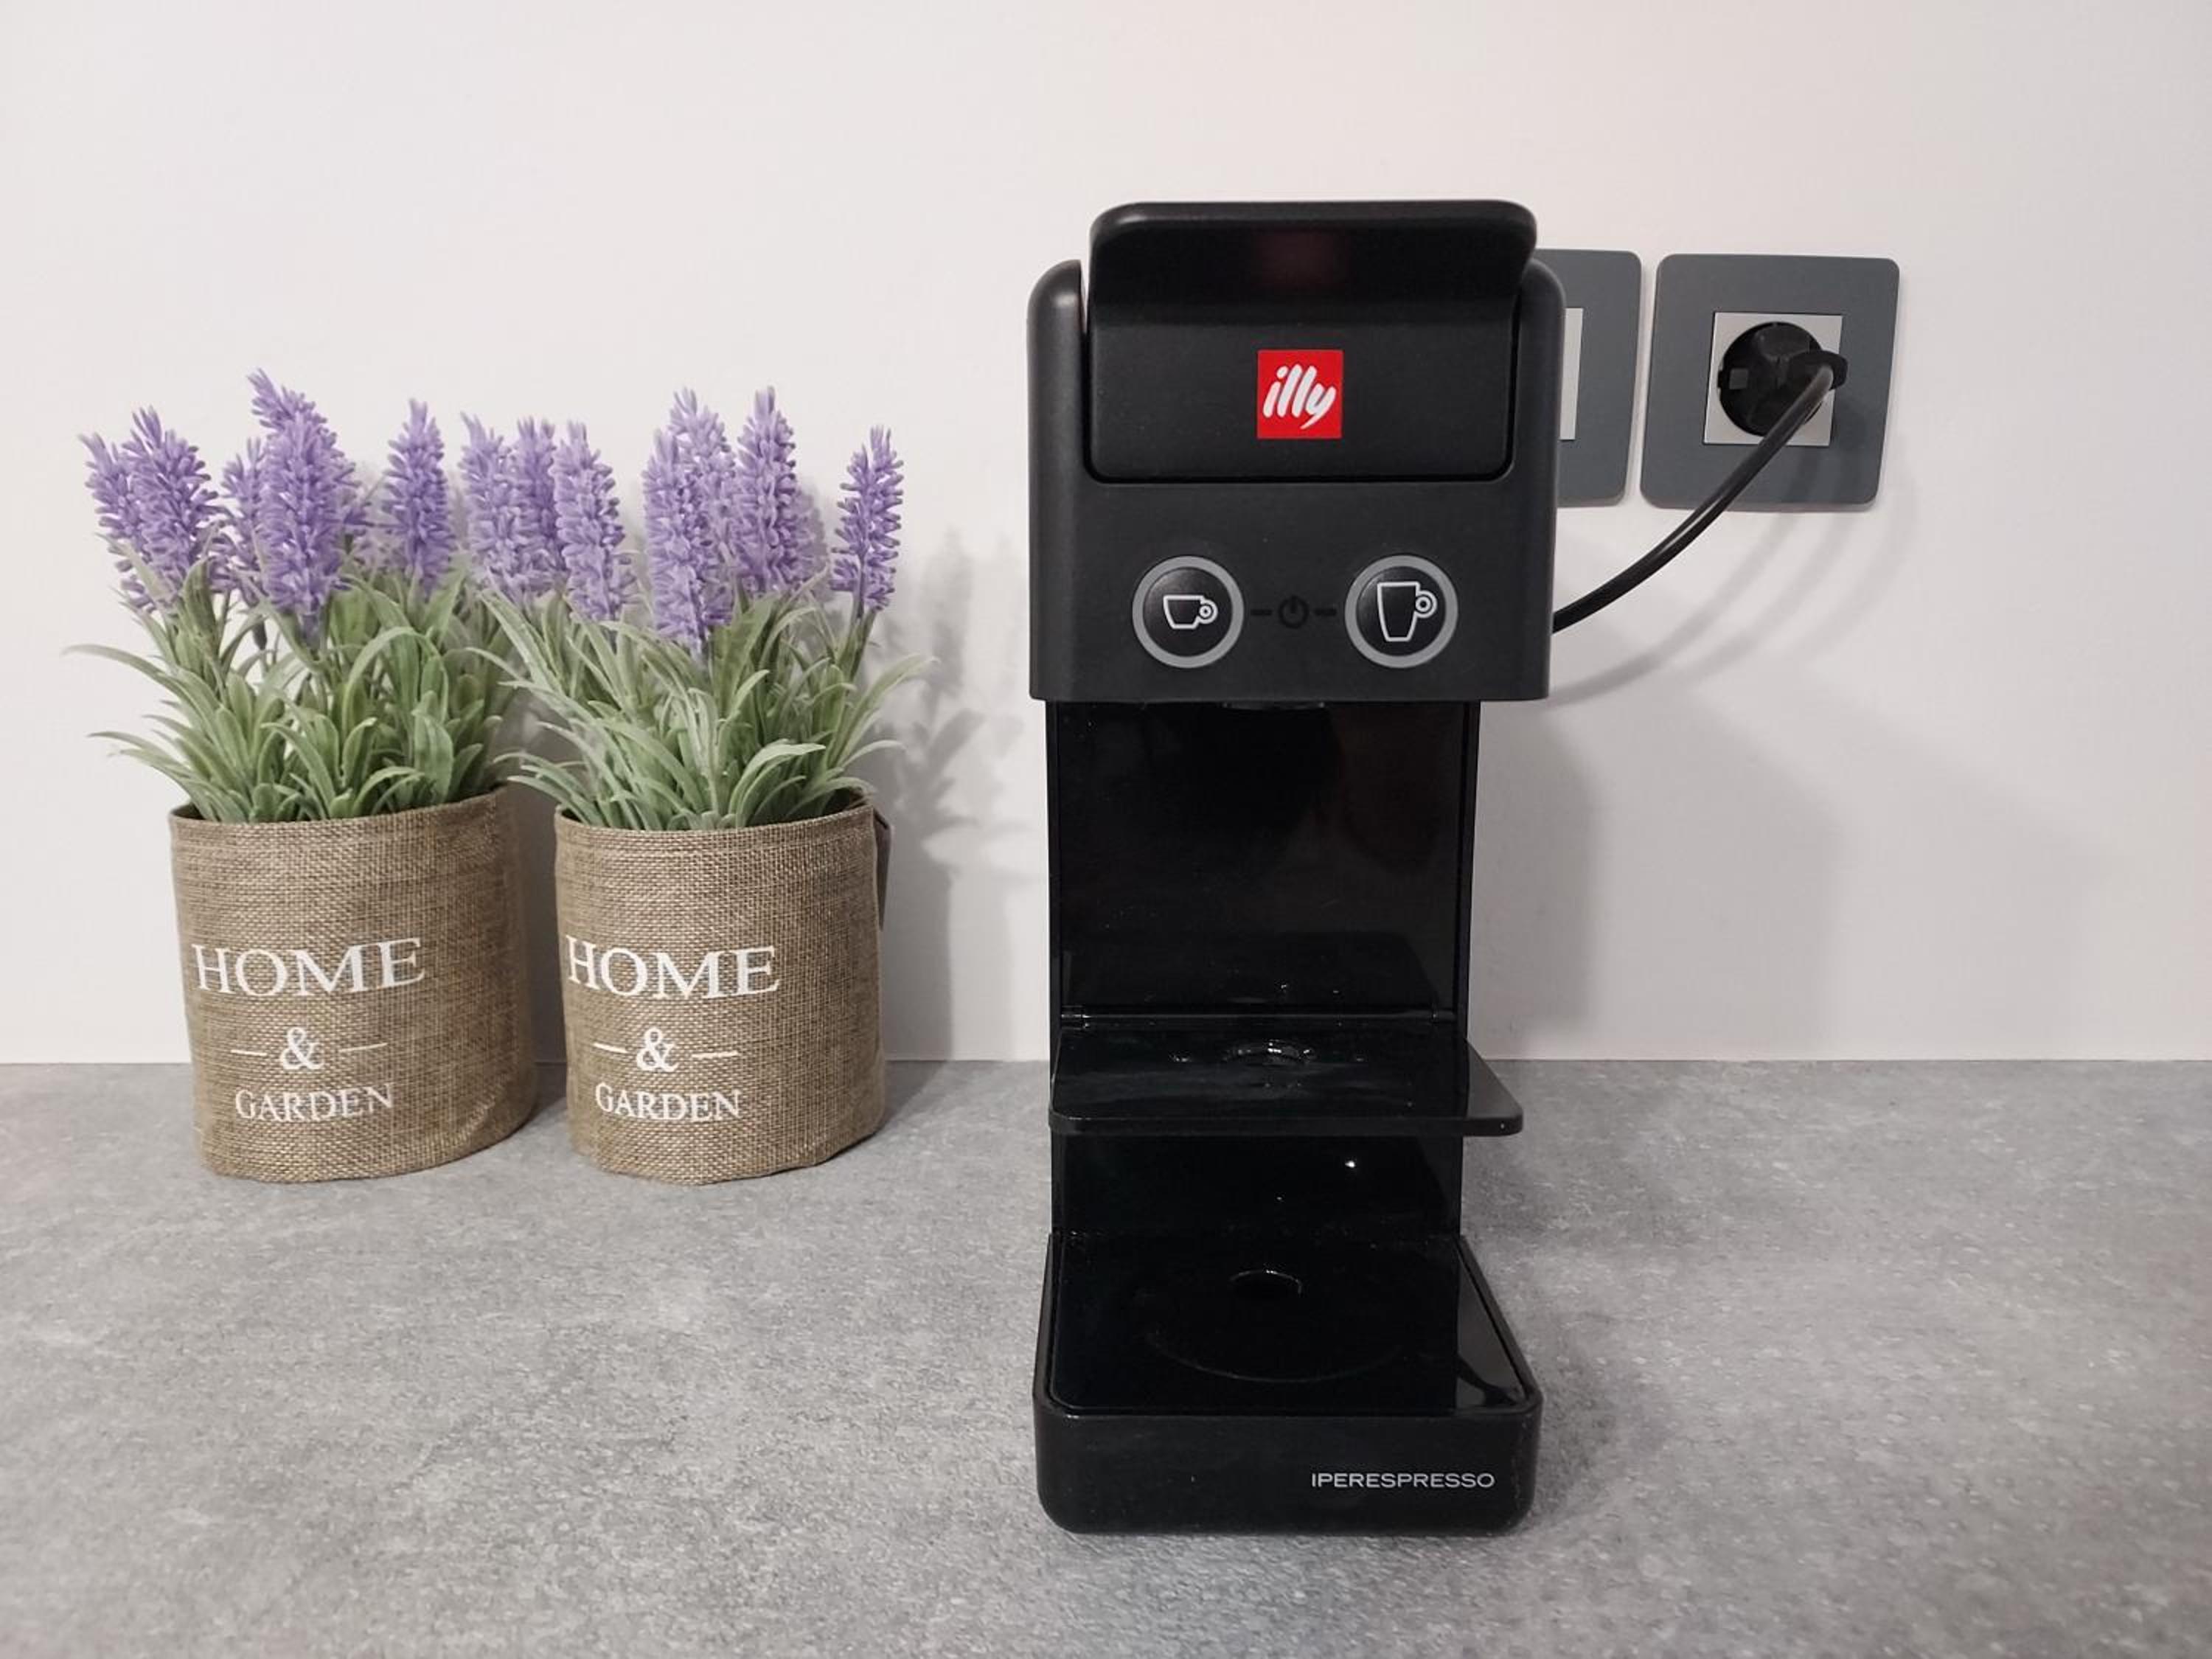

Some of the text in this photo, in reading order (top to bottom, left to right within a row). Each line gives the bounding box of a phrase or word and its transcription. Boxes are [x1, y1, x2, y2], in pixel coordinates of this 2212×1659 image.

[1262, 363, 1337, 430] illy
[192, 936, 426, 998] HOME
[566, 934, 780, 1001] HOME
[278, 1026, 324, 1071] &
[634, 1026, 679, 1073] &
[234, 1082, 394, 1123] GARDEN
[595, 1084, 740, 1123] GARDEN
[1311, 1472, 1495, 1488] IPERESPRESSO
